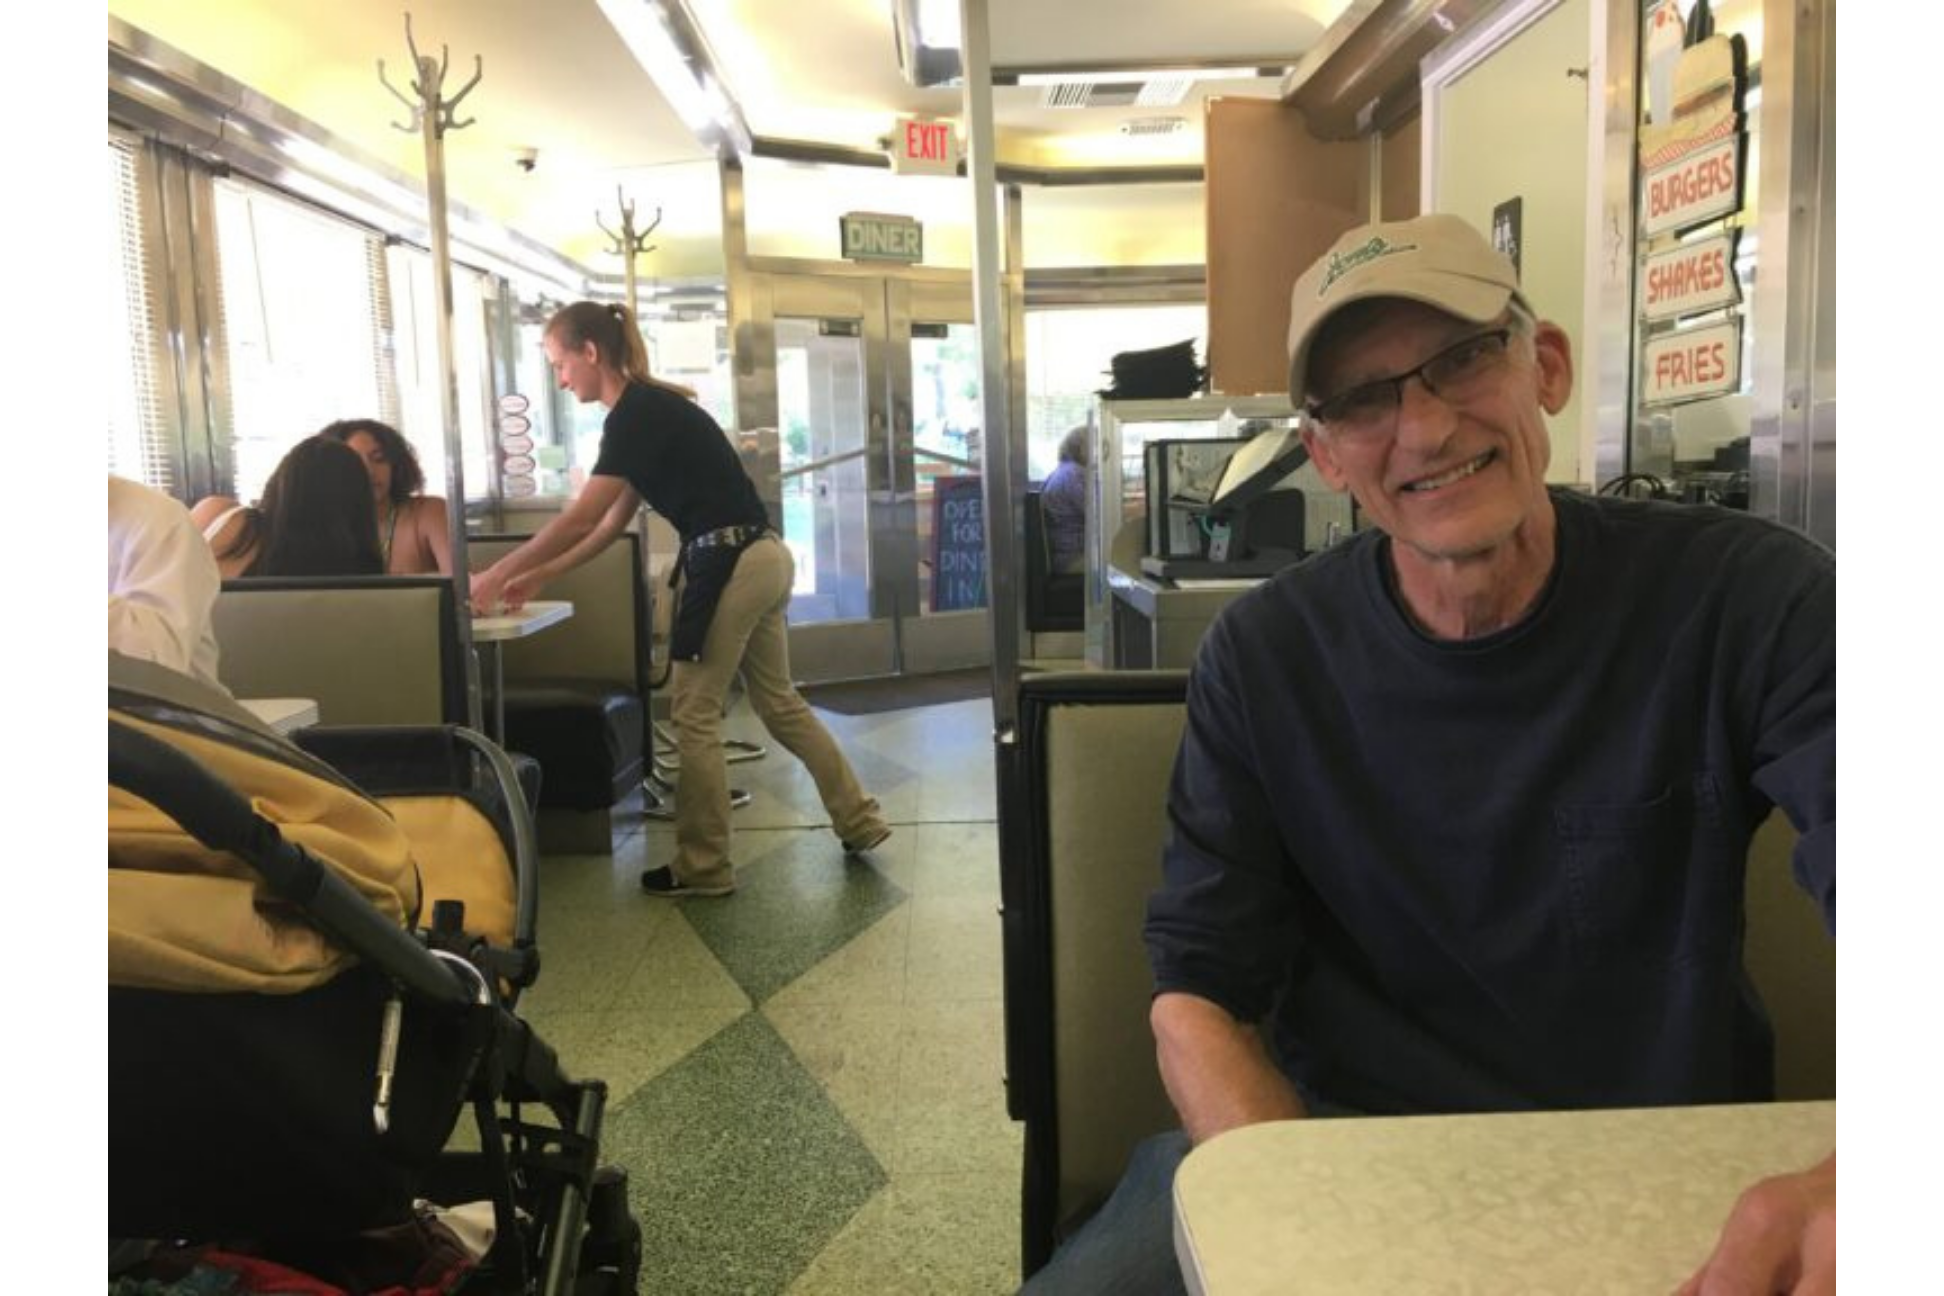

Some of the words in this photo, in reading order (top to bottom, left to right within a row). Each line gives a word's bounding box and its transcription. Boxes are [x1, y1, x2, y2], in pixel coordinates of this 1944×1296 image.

[906, 121, 948, 162] EXIT
[1649, 151, 1734, 218] BURGERS
[849, 219, 921, 254] DINER
[1646, 249, 1725, 304] SHAKES
[1655, 342, 1725, 390] FRIES
[944, 498, 982, 520] OPE
[952, 522, 982, 543] FOR
